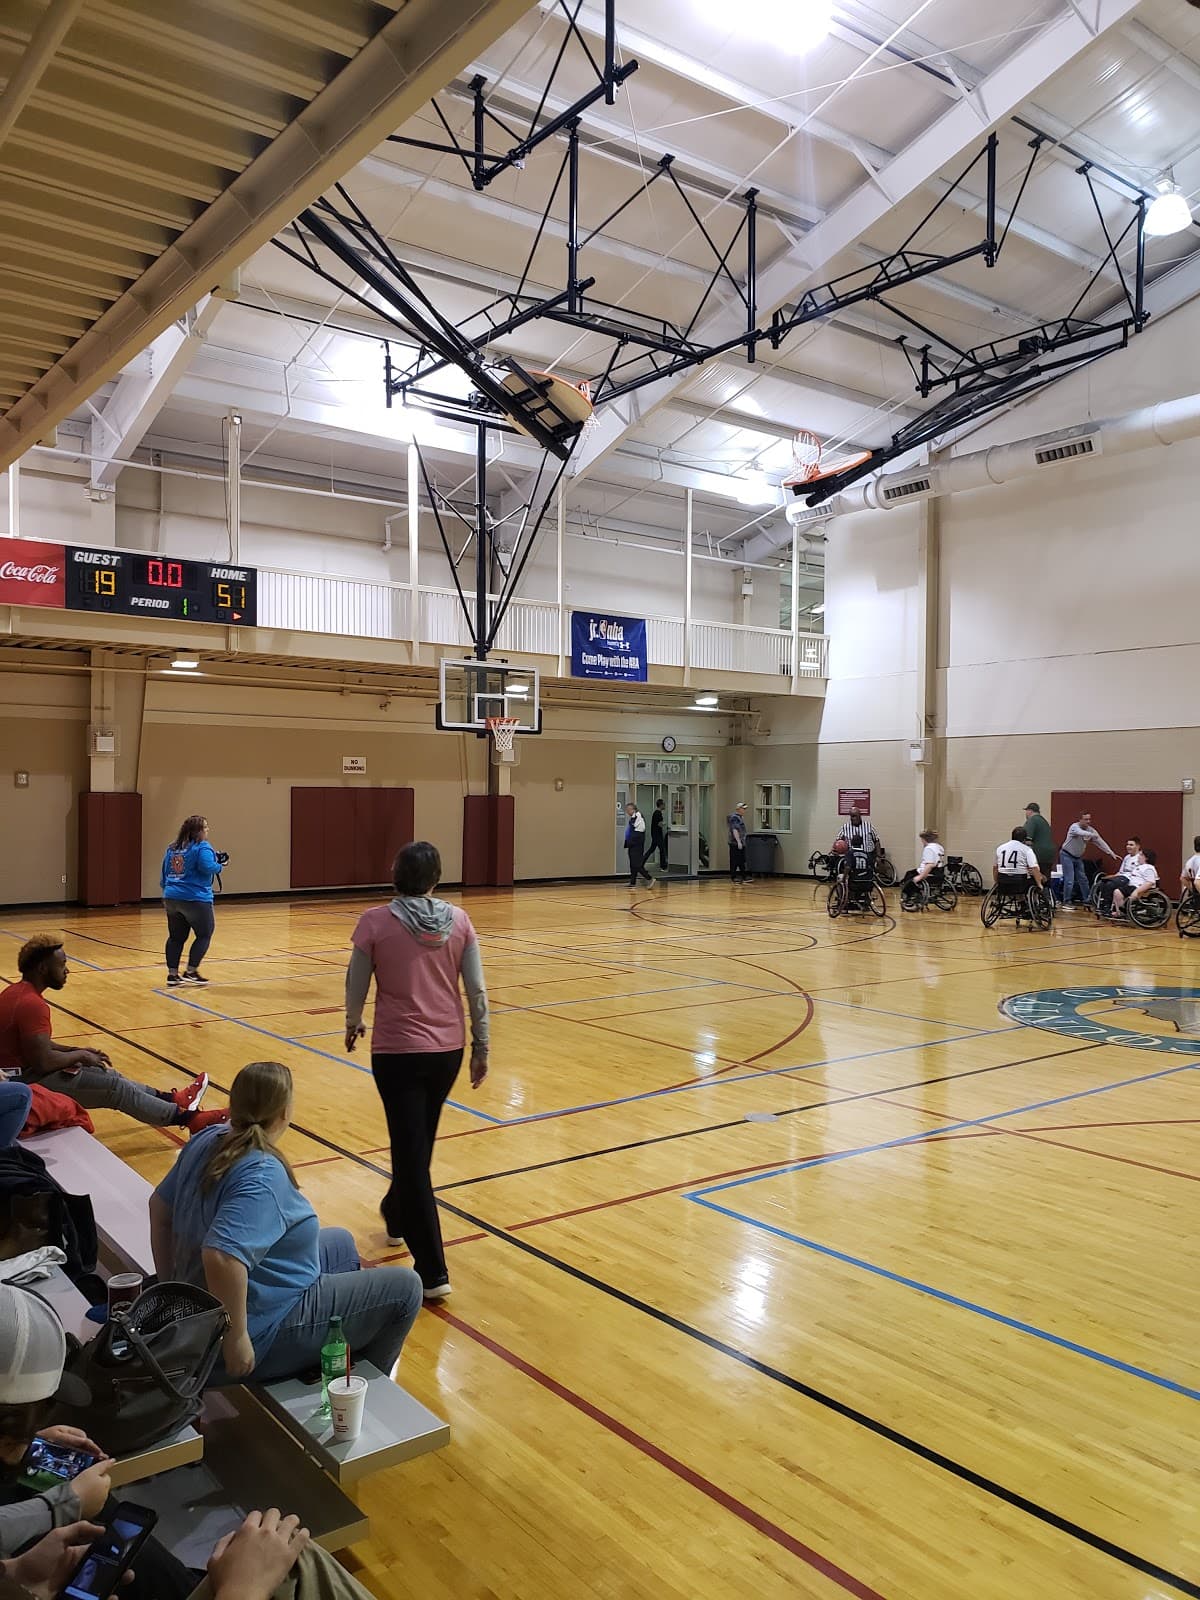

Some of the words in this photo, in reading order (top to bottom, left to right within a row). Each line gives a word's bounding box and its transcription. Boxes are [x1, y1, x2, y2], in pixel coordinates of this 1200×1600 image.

[74, 551, 120, 566] GUEST
[0, 561, 59, 584] Coca-Cola
[95, 570, 116, 595] 19
[148, 560, 182, 588] 0.0
[211, 568, 247, 581] HOME
[131, 597, 169, 609] PERIOD
[217, 583, 245, 608] 51
[589, 619, 600, 641] jr.
[607, 622, 623, 640] nba
[582, 652, 597, 666] Come
[598, 654, 608, 668] Play
[609, 656, 620, 668] with
[1000, 850, 1018, 868] 14
